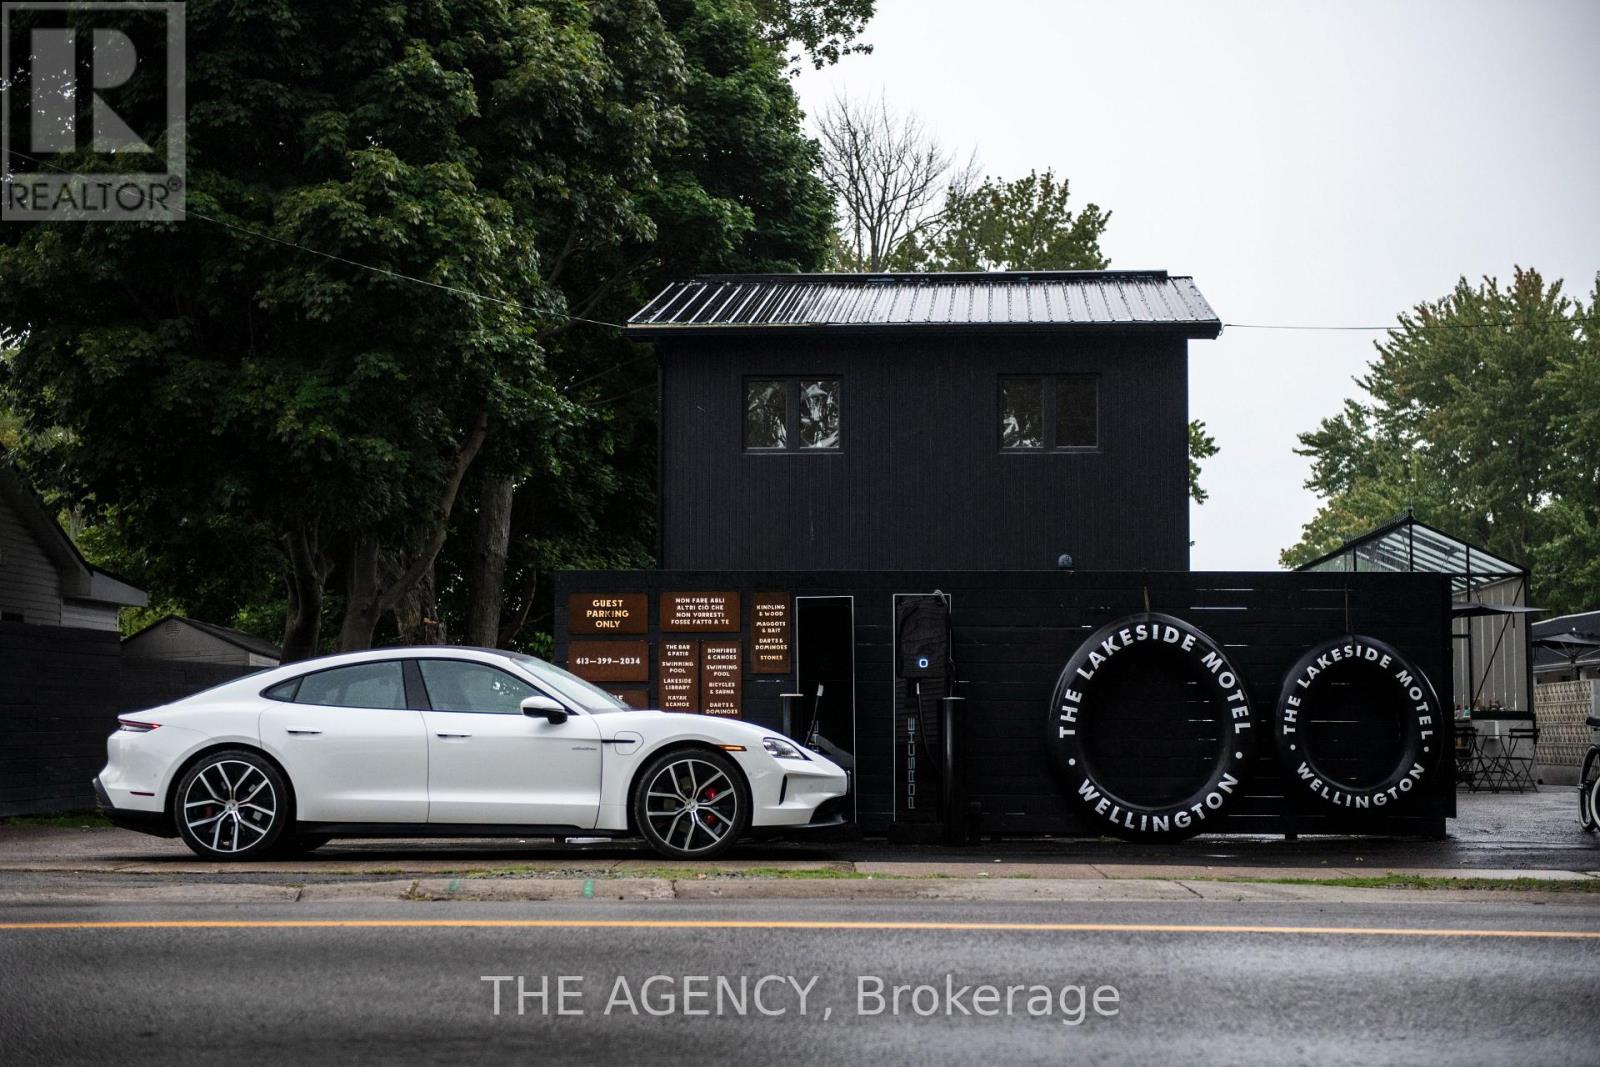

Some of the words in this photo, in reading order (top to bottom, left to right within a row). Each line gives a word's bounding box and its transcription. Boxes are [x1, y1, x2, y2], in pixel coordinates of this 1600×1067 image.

[1059, 689, 1082, 739] THE
[1076, 624, 1197, 681] LAKESIDE
[1201, 651, 1251, 734] MOTEL
[1283, 695, 1301, 735] THE
[1297, 645, 1392, 688] LAKESIDE
[1395, 669, 1433, 740] MOTEL
[907, 717, 916, 809] PORSCHE
[1077, 772, 1239, 832] WELLINGTON
[1297, 761, 1425, 809] WELLINGTON
